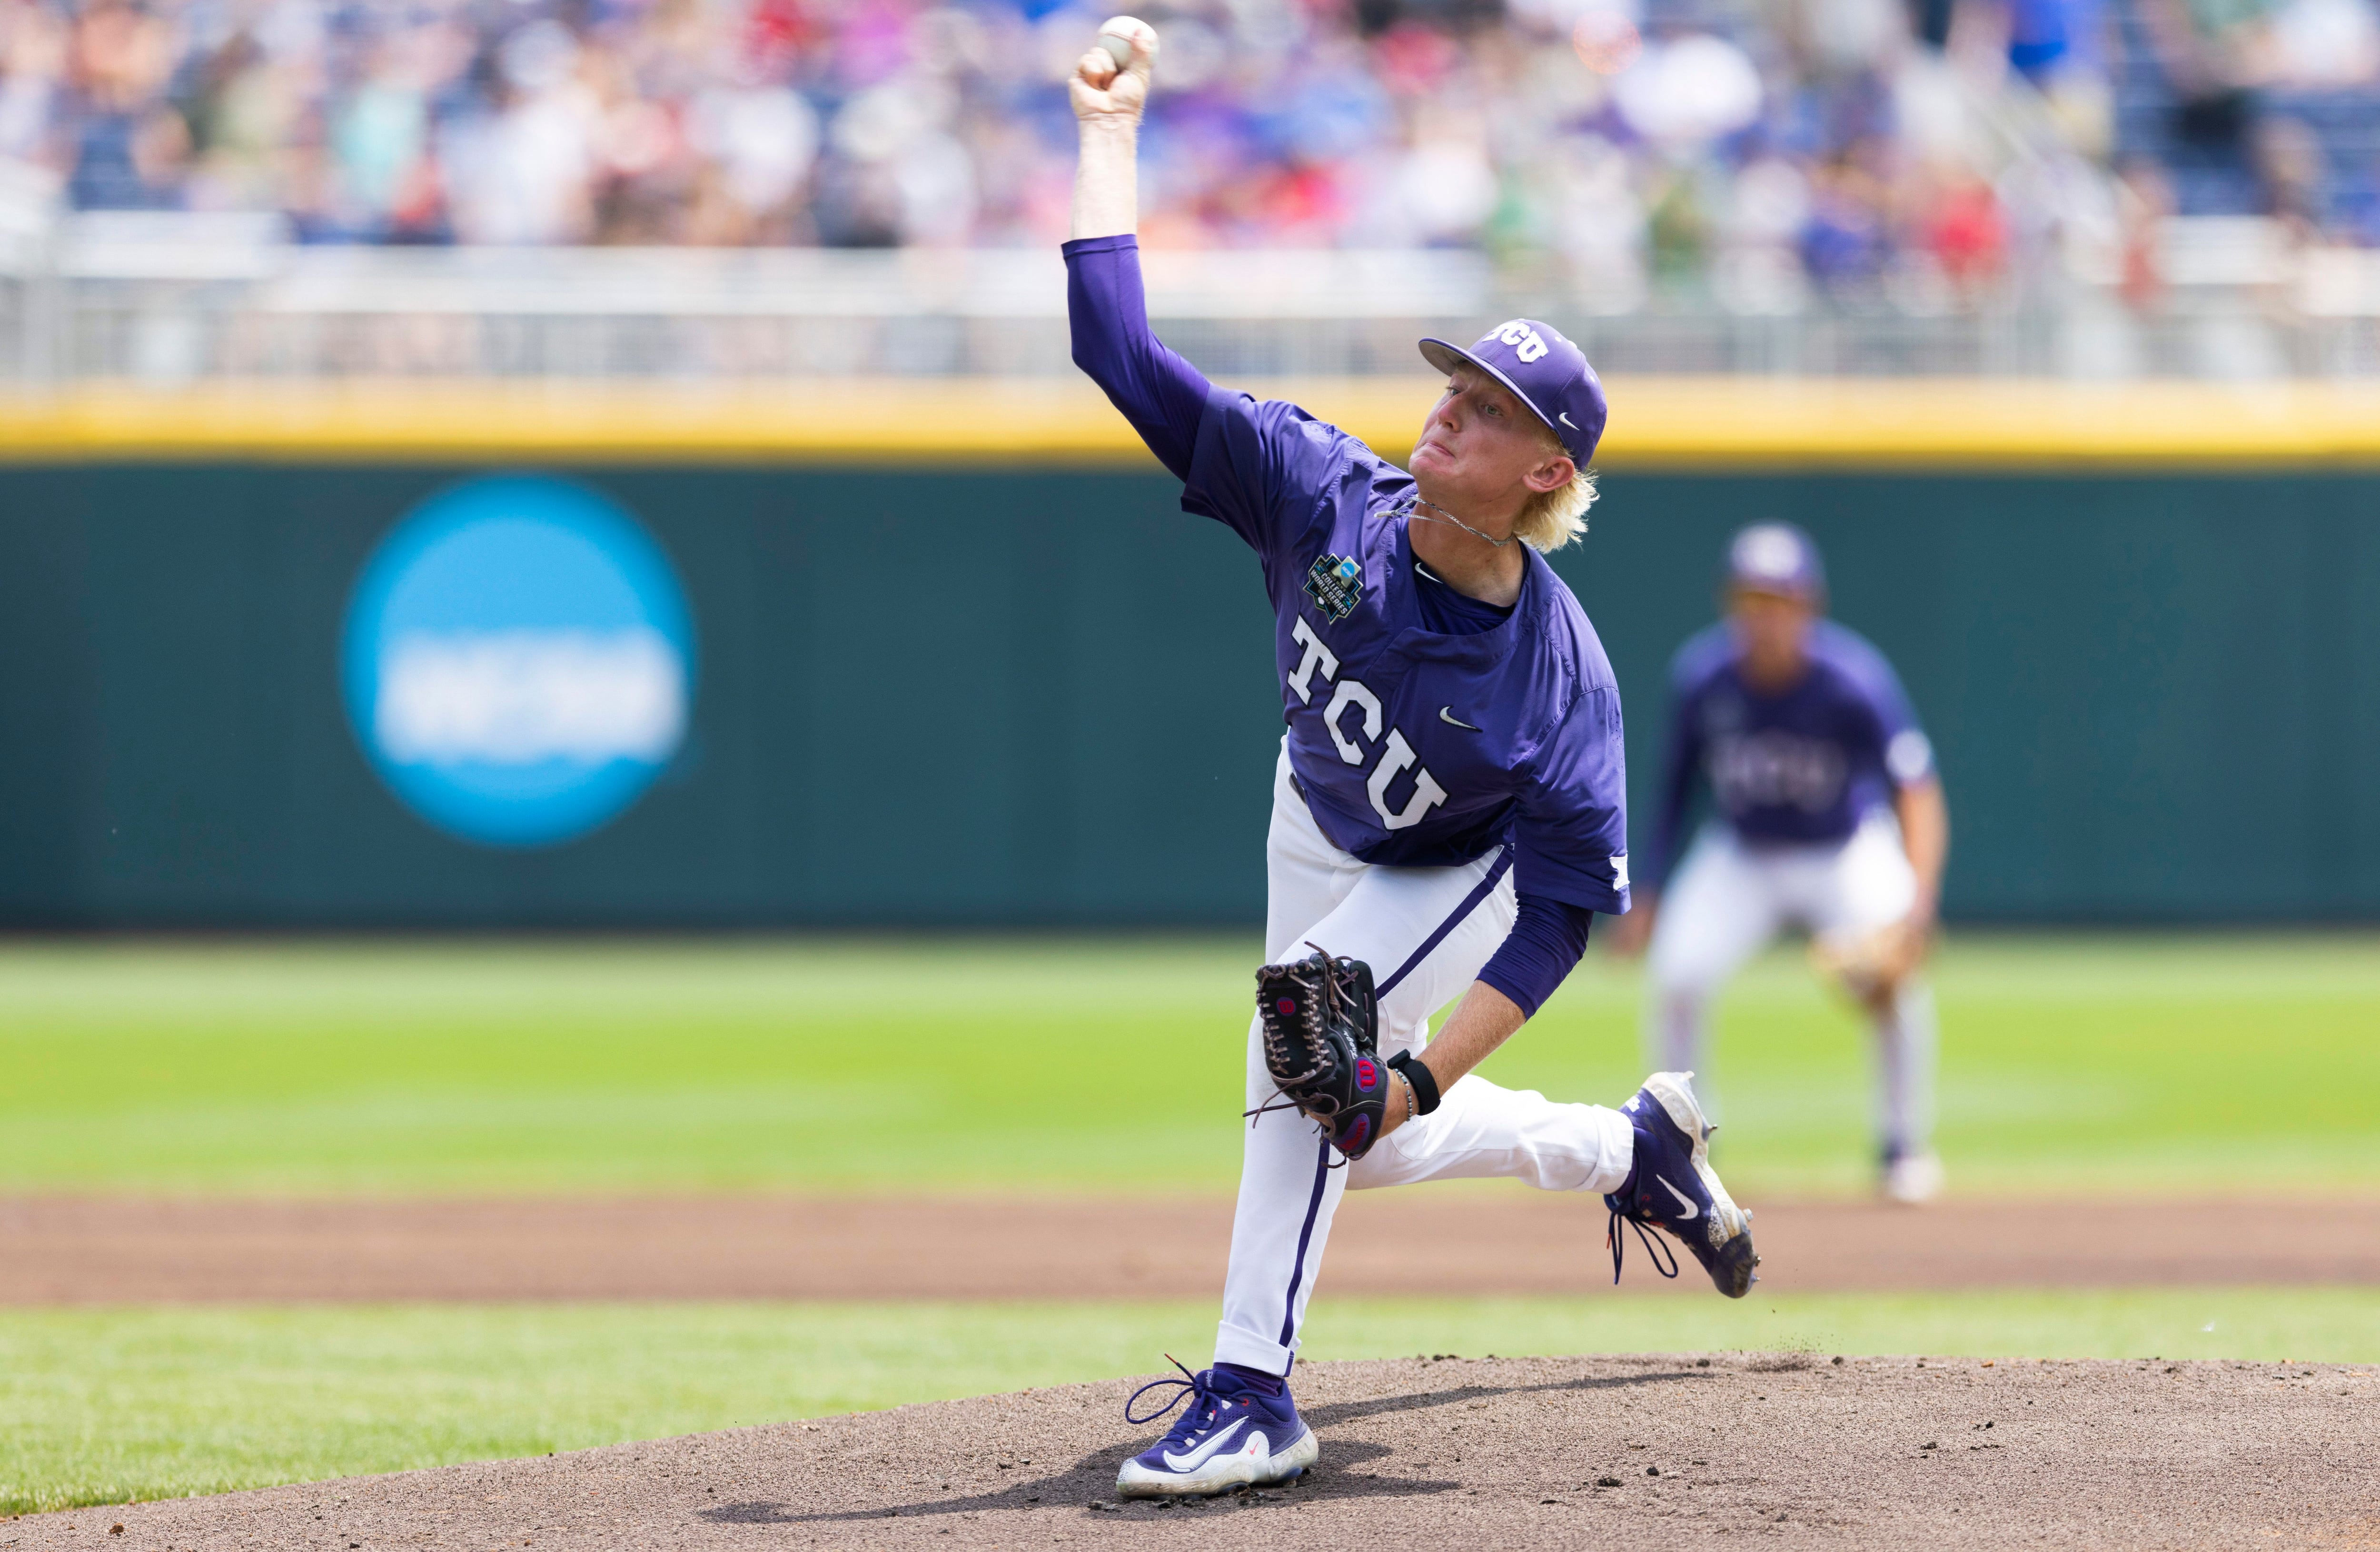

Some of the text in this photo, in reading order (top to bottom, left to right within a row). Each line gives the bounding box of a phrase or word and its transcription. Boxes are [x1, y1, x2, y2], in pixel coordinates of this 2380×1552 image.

[1482, 321, 1549, 364] TCU
[1310, 569, 1348, 614] WORLD SERIES
[1318, 589, 1331, 605] OMAHA
[1321, 573, 1346, 600] COLLEGE
[1287, 613, 1450, 831] TCU
